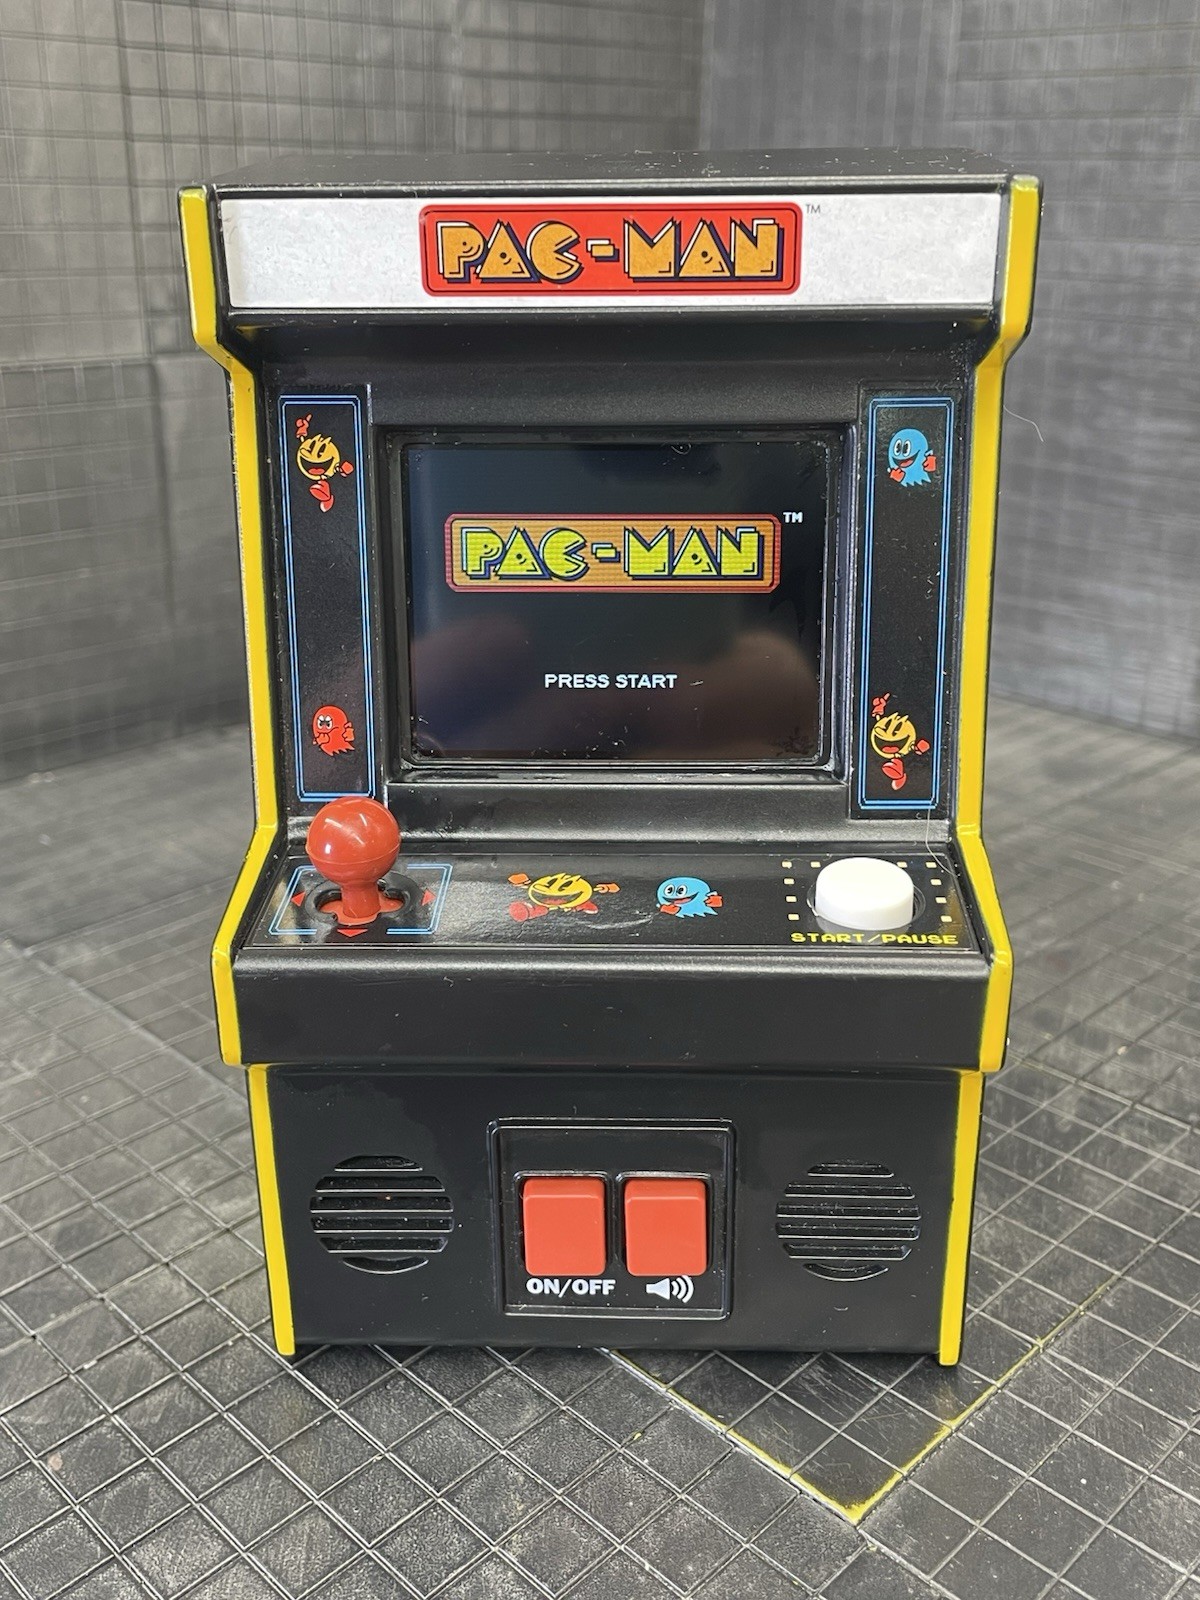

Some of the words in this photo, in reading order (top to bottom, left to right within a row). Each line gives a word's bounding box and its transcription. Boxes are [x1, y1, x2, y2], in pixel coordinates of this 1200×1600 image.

[436, 216, 785, 284] PAC-MAN
[460, 525, 765, 581] PAC-MAN
[544, 673, 610, 689] PRESS
[615, 673, 678, 689] START
[790, 932, 959, 945] START/PAUSE
[525, 1277, 616, 1298] ON/OFF
